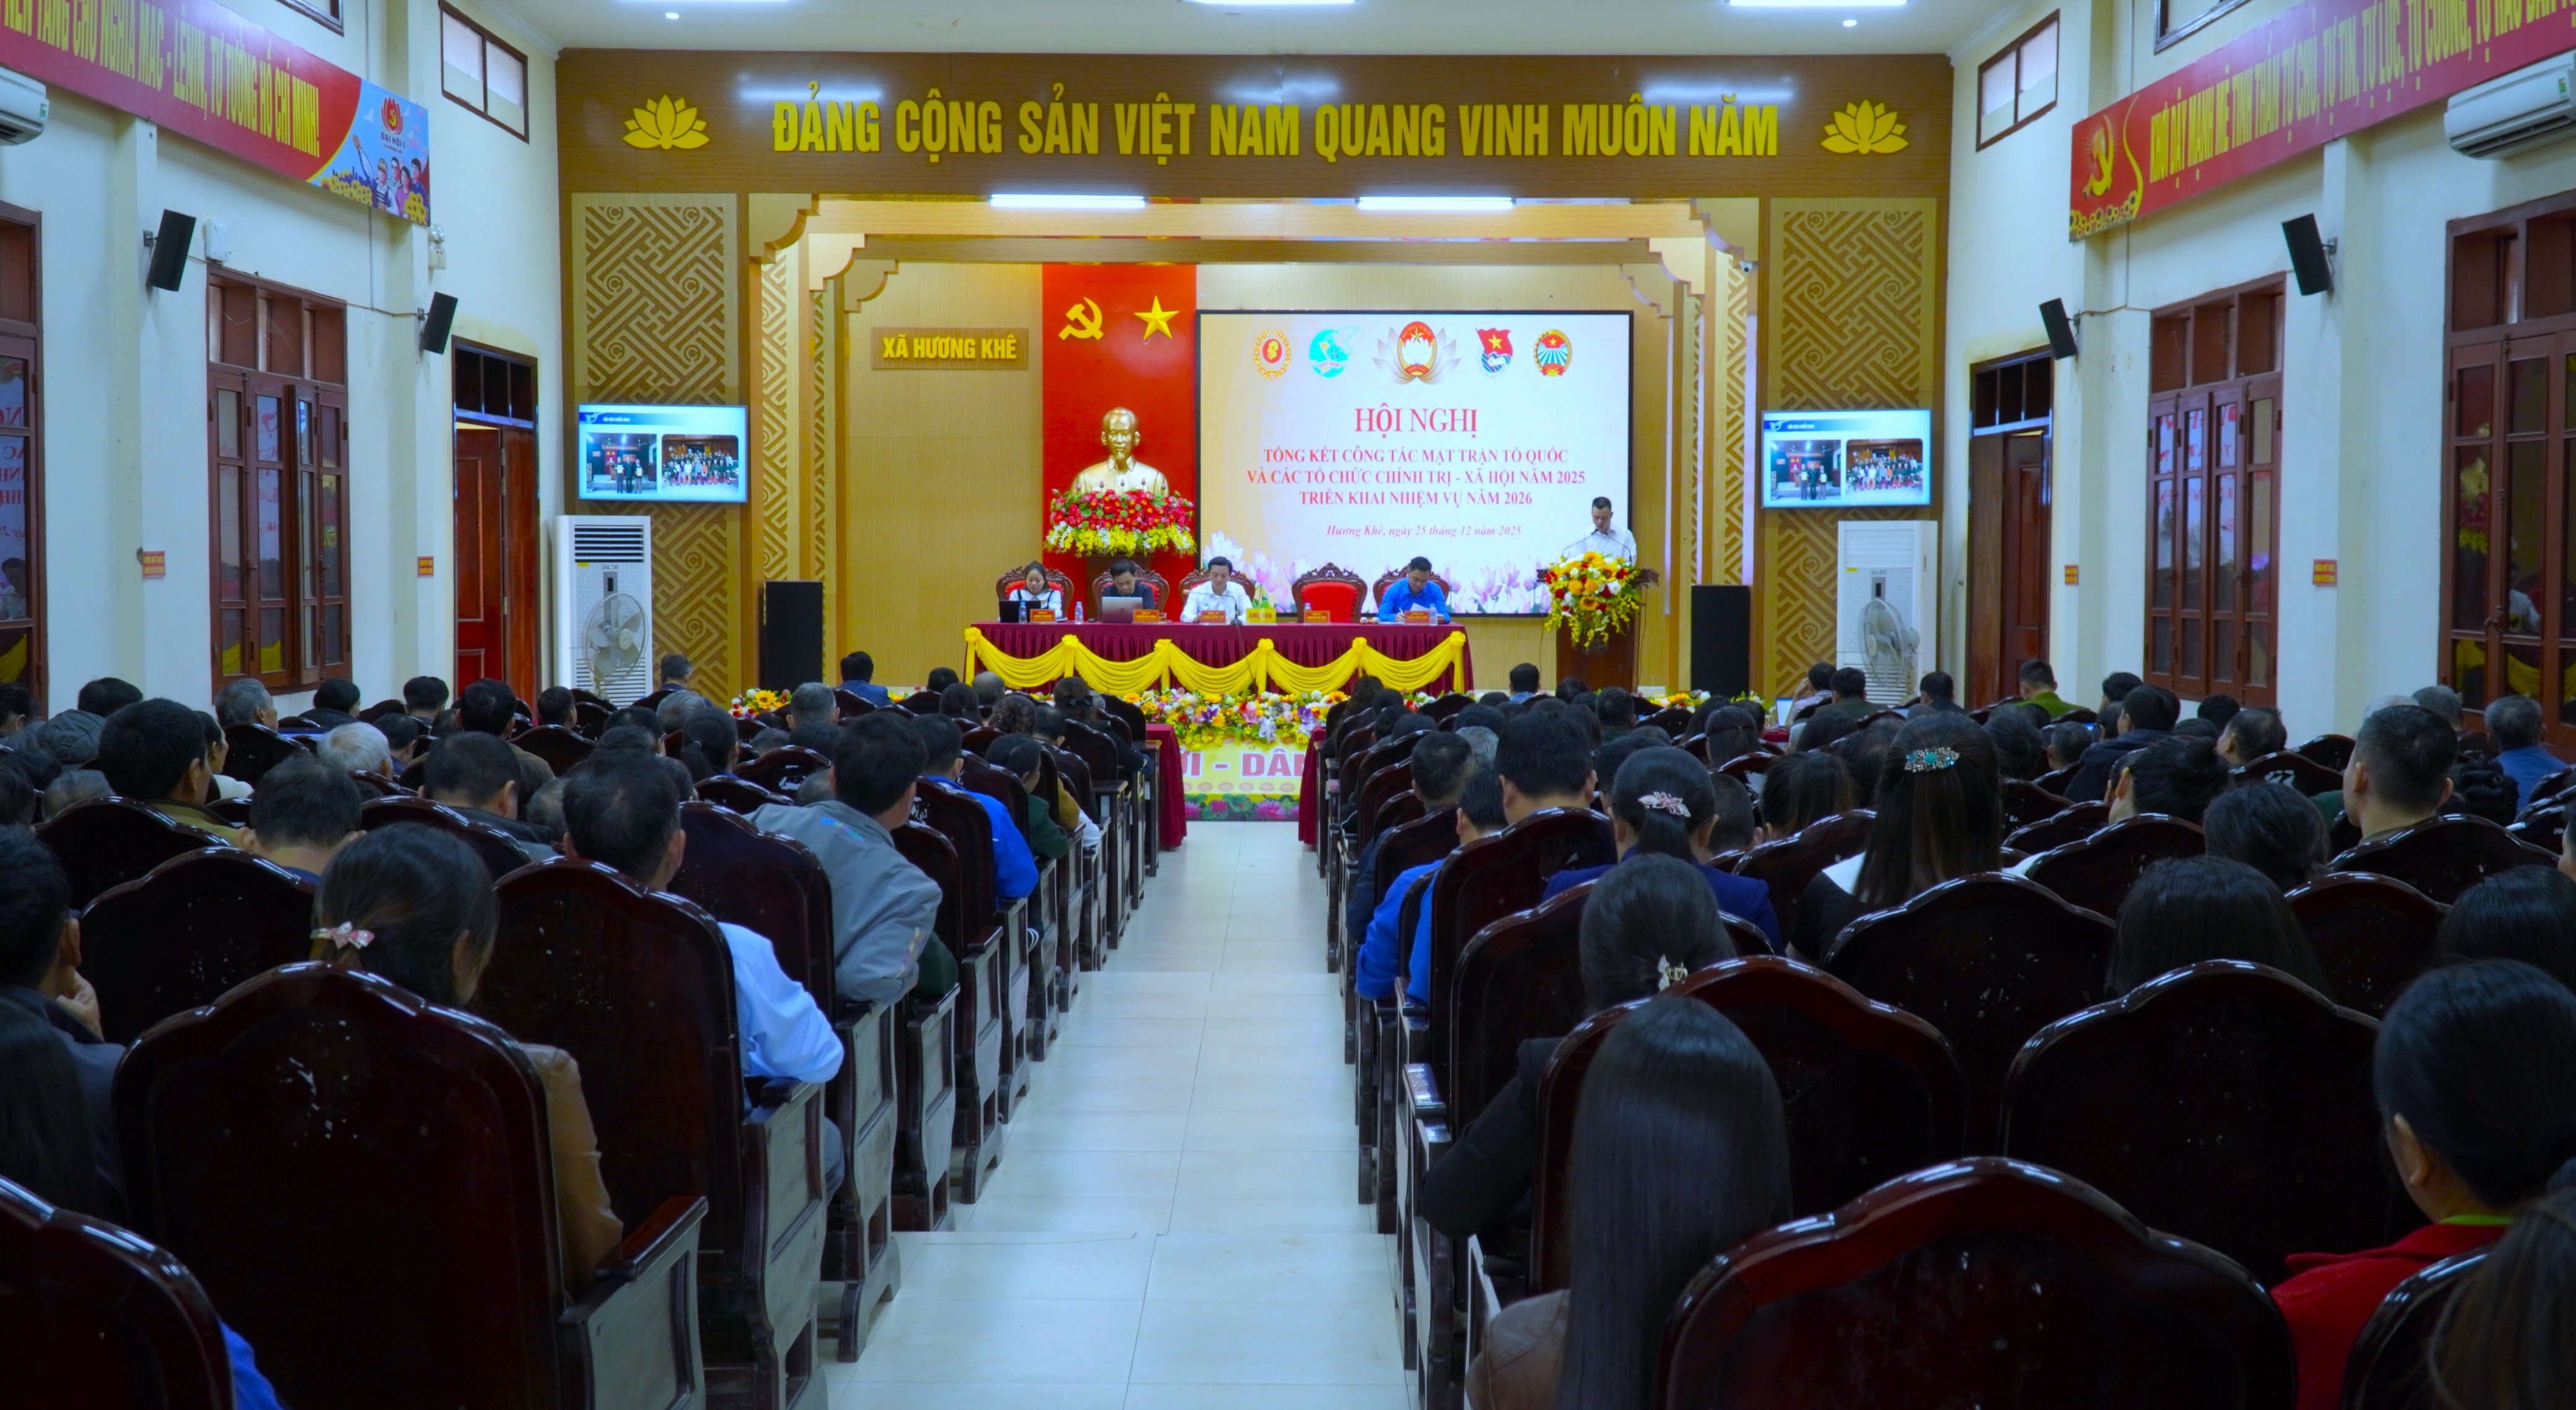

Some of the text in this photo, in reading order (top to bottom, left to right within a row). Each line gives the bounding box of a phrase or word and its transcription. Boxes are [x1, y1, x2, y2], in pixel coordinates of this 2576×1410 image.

[260, 38, 273, 138] HỒ
[275, 57, 291, 146] CHÍ
[292, 75, 320, 158] MINH!
[772, 80, 1779, 166] ĐẢNG CỘNG SẢN VIỆT NAM QUANG VINH MUÔN NĂM
[2170, 87, 2187, 189] DẬY
[2187, 85, 2215, 181] MẠNH
[2231, 67, 2254, 149] TINH
[882, 333, 1017, 359] XÃ HƯƠNG KHÊ
[1354, 402, 1478, 438] HỘI NGHỊ
[1264, 445, 1568, 466] TỔNG KẾT CÔNG TÁC MẶT TRẬN TỔ QUỐC
[1247, 466, 1267, 484] VÀ
[1270, 466, 1301, 484] CÁC
[1304, 466, 1325, 484] TỔ
[1329, 466, 1372, 484] CHỨC
[1375, 466, 1423, 484] CHÍNH
[1426, 470, 1452, 487] TRỊ
[1464, 468, 1484, 484] XÃ
[1488, 468, 1515, 487] HỘI
[1519, 467, 1553, 484] NĂM
[1556, 470, 1585, 484] 2025
[1299, 488, 1532, 508] TRIỂN KHAI NHIỆM VỤ NĂM 2026
[1327, 525, 1522, 538] Hương Khê, ngày 25 tháng 12 năm 2025
